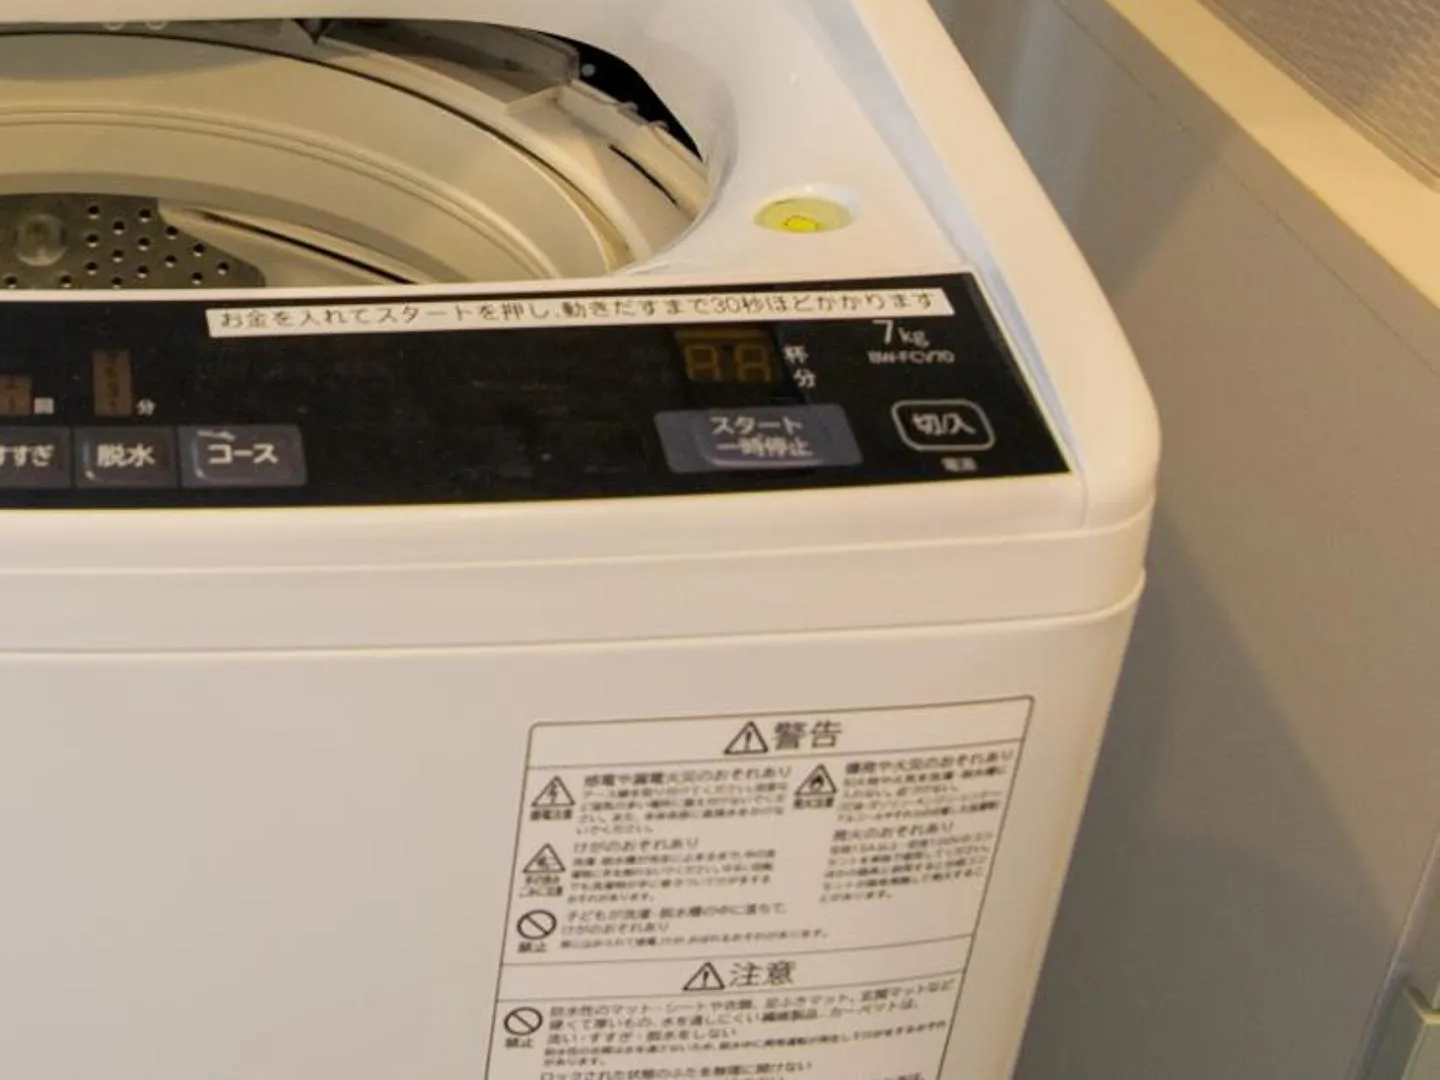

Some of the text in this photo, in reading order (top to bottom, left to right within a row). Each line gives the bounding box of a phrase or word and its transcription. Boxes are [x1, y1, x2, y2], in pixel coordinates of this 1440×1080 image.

[871, 319, 931, 348] 7kg
[793, 368, 817, 388] 分
[135, 398, 157, 416] 分
[709, 415, 803, 435] スタート
[96, 443, 157, 468] 脱水
[208, 441, 279, 466] コース
[716, 435, 814, 458] 一時停止
[772, 719, 845, 751] 警告
[573, 837, 700, 854] けがのおそれあり
[729, 960, 797, 987] 注意
